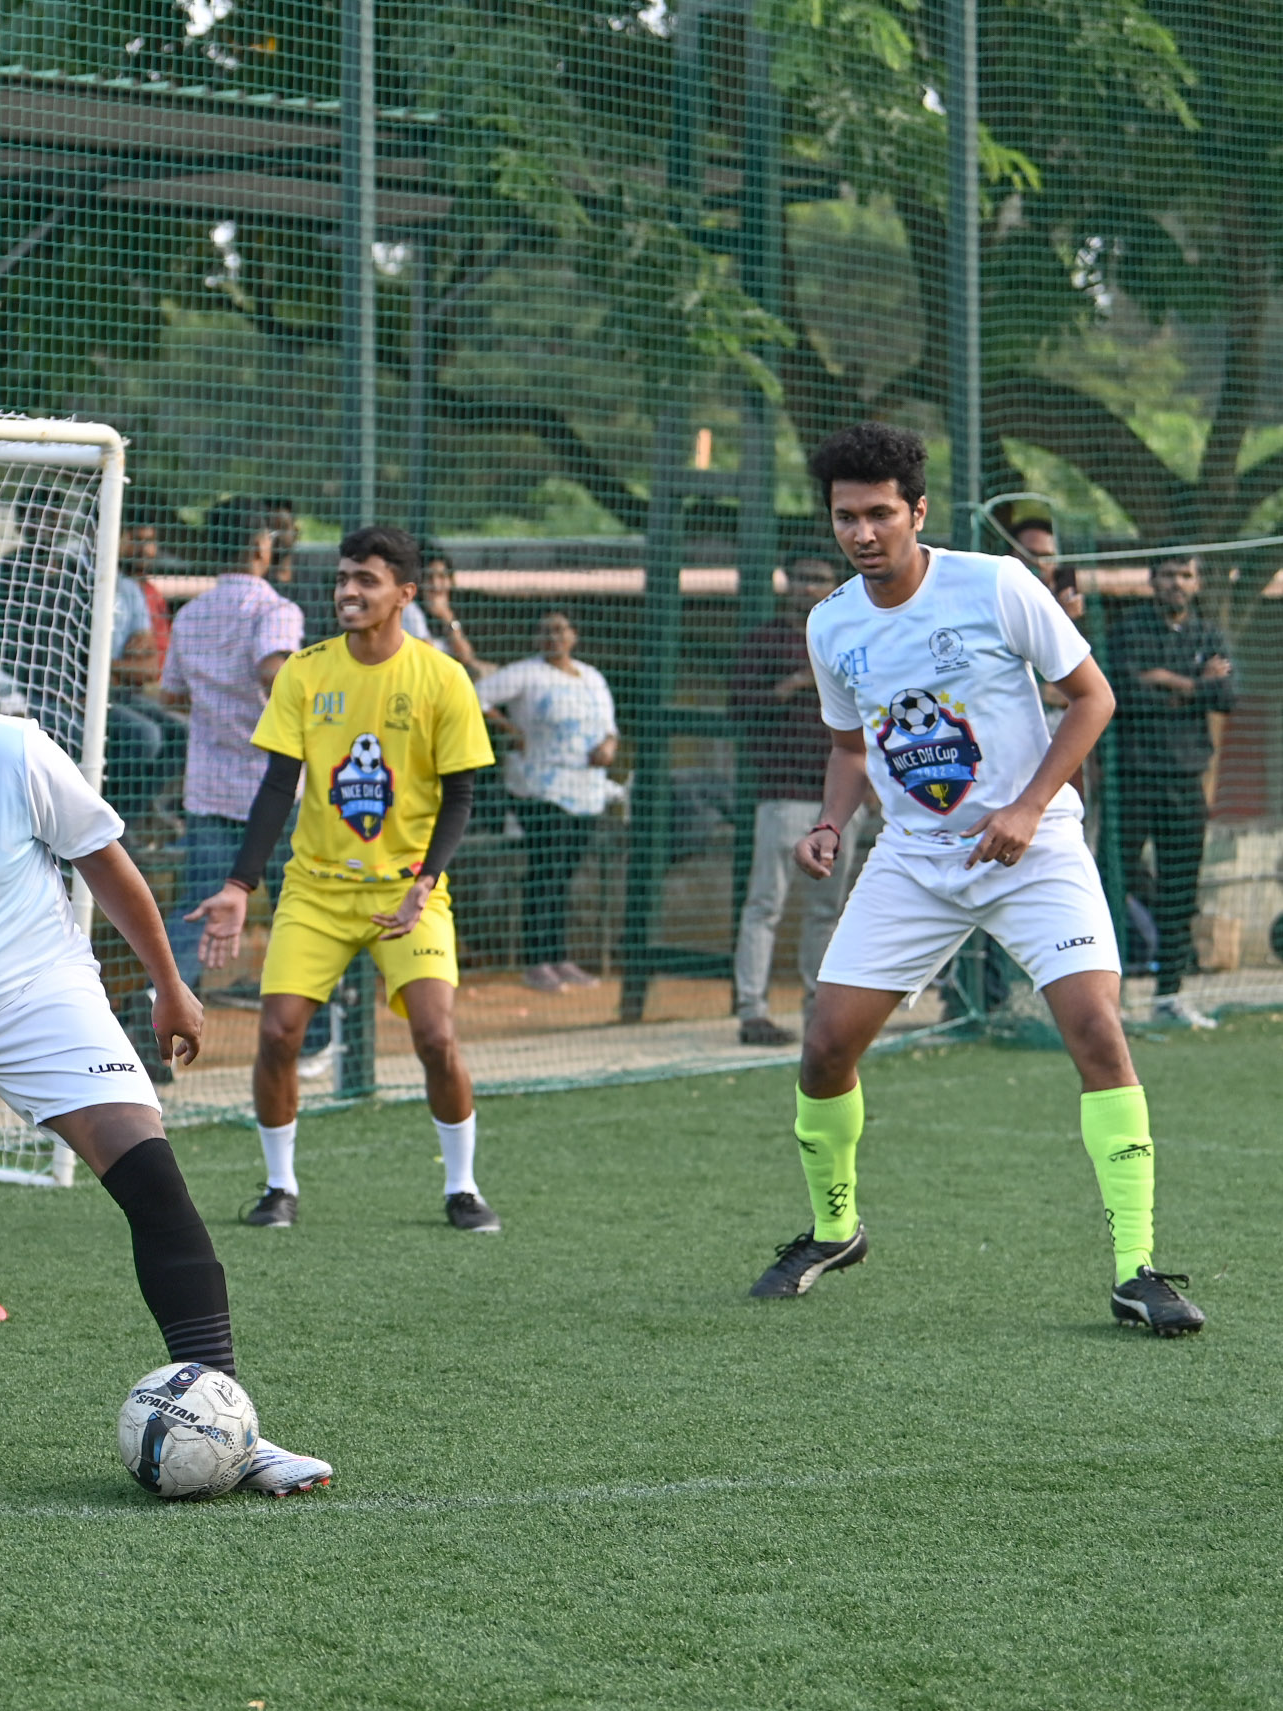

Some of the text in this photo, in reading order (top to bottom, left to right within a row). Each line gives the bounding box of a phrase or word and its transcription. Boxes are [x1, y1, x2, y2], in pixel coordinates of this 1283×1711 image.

[313, 691, 345, 715] DH
[892, 745, 958, 772] NICE DH Cup
[1055, 936, 1096, 951] LUDIZ
[88, 1063, 137, 1074] LUDIZ
[135, 1394, 201, 1424] SPARTAN
